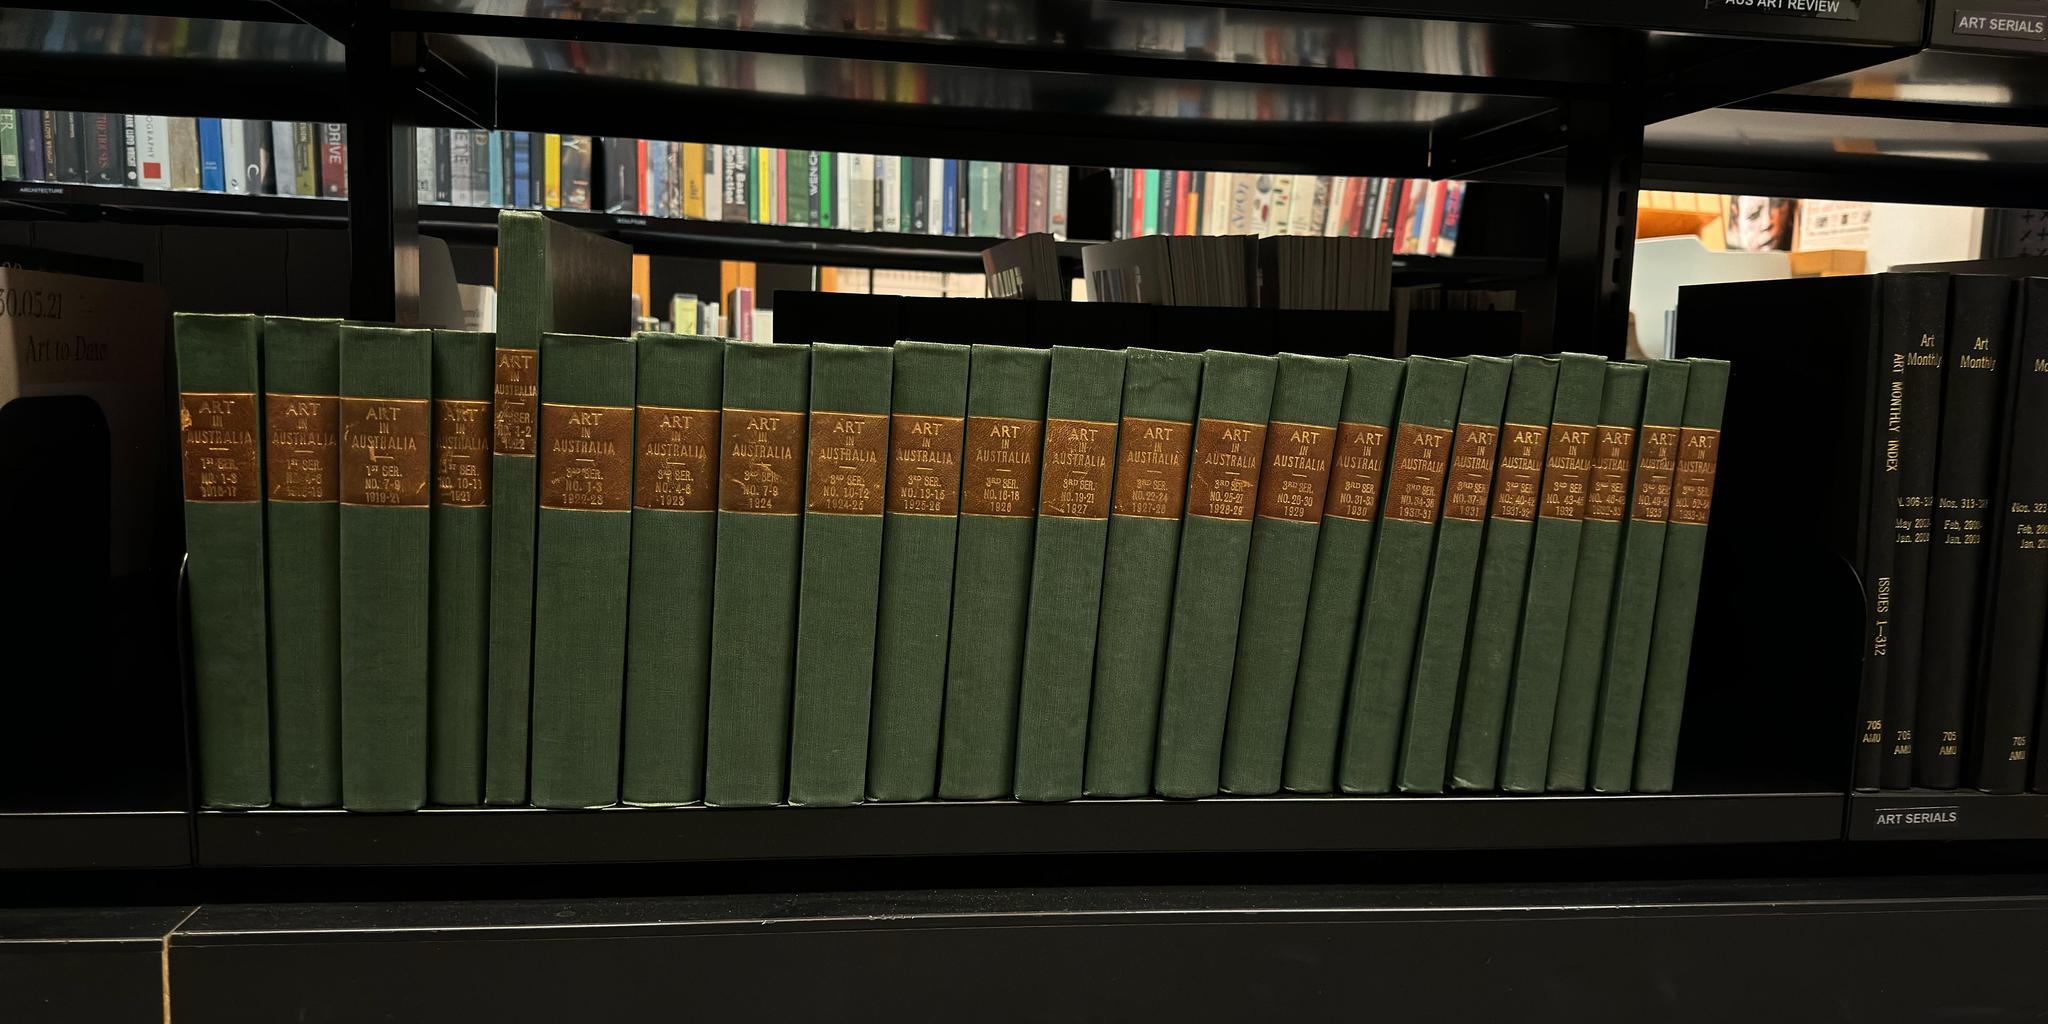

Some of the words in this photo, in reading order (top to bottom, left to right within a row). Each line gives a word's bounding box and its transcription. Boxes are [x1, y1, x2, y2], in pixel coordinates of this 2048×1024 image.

[1788, 0, 1839, 13] REVIEW
[1959, 16, 1986, 29] ART
[1990, 19, 2043, 33] SERIALS
[1921, 334, 1935, 347] Art
[1974, 337, 1989, 350] Art
[499, 354, 533, 368] ART
[1893, 353, 1905, 374] ART
[1907, 352, 1942, 368] Monthly
[1960, 355, 1996, 371] Monthly
[495, 384, 537, 396] AUSTRALIA
[199, 401, 235, 414] ART
[286, 402, 320, 415] ART
[366, 407, 400, 420] ART
[1888, 382, 1904, 433] MONTHLY
[444, 409, 478, 421] ART
[569, 413, 603, 426] ART
[380, 423, 389, 434] IN
[660, 416, 693, 429] ART
[747, 418, 780, 431] ART
[833, 421, 865, 434] ART
[912, 422, 943, 436] ART
[187, 431, 252, 444] AUSTRALIA
[581, 427, 590, 438] IN
[672, 432, 681, 442] IN
[758, 432, 767, 442] IN
[990, 425, 1020, 438] ART
[1068, 428, 1098, 441] ART
[1144, 427, 1173, 440] ART
[1222, 428, 1251, 442] ART
[1291, 430, 1320, 444] ART
[1514, 431, 1542, 444] ART
[1560, 431, 1590, 444] ART
[352, 435, 416, 450] AUSTRALIA
[846, 436, 854, 446] IN
[922, 438, 930, 447] IN
[1002, 439, 1010, 449] IN
[1354, 432, 1383, 445] ART
[1413, 433, 1443, 447] ART
[1467, 432, 1495, 445] ART
[1602, 432, 1631, 445] ART
[1648, 433, 1676, 445] ART
[1688, 435, 1715, 448] ART
[553, 440, 616, 455] AUSTRALIA
[646, 443, 707, 459] AUSTRALIA
[732, 444, 792, 459] AUSTRALIA
[1079, 442, 1086, 452] IN
[1154, 442, 1162, 452] IN
[1231, 443, 1239, 453] IN
[1300, 445, 1308, 456] IN
[1363, 446, 1371, 456] IN
[1423, 449, 1432, 458] IN
[1477, 446, 1485, 456] IN
[1523, 446, 1531, 456] IN
[1569, 446, 1577, 455] IN
[1612, 448, 1619, 457] IN
[1659, 448, 1666, 456] IN
[819, 449, 877, 463] AUSTRALIA
[896, 448, 954, 465] AUSTRALIA
[976, 449, 1031, 464] AUSTRALIA
[1052, 452, 1106, 467] AUSTRALIA
[1127, 451, 1180, 466] AUSTRALIA
[1205, 453, 1256, 468] AUSTRALIA
[1698, 450, 1705, 459] IN
[1886, 440, 1899, 472] INDEX
[1274, 455, 1325, 471] AUSTRALIA
[1401, 459, 1444, 473] AUSTRALIA
[566, 480, 583, 491] NO.
[587, 481, 603, 493] 1-3
[656, 482, 671, 494] NO.
[1003, 479, 1018, 489] SER.
[1080, 480, 1095, 490] SER.
[1299, 482, 1313, 494] SER.
[1422, 485, 1435, 496] SER.
[743, 485, 759, 496] NO.
[764, 485, 779, 497] 7-9
[823, 485, 838, 497] NO.
[901, 488, 916, 498] NO.
[1132, 491, 1145, 500] NO.
[1210, 491, 1223, 502] NO.
[1278, 493, 1291, 504] NO.
[1340, 493, 1354, 504] NO.
[1284, 506, 1304, 517] 1929
[1877, 577, 1891, 613] ISSUES
[1867, 720, 1881, 730] 705
[1897, 730, 1911, 741] 705
[1943, 731, 1956, 741] 705
[2012, 737, 2026, 746] 705
[1877, 814, 1903, 825] ART
[1905, 812, 1957, 824] SERIALS
